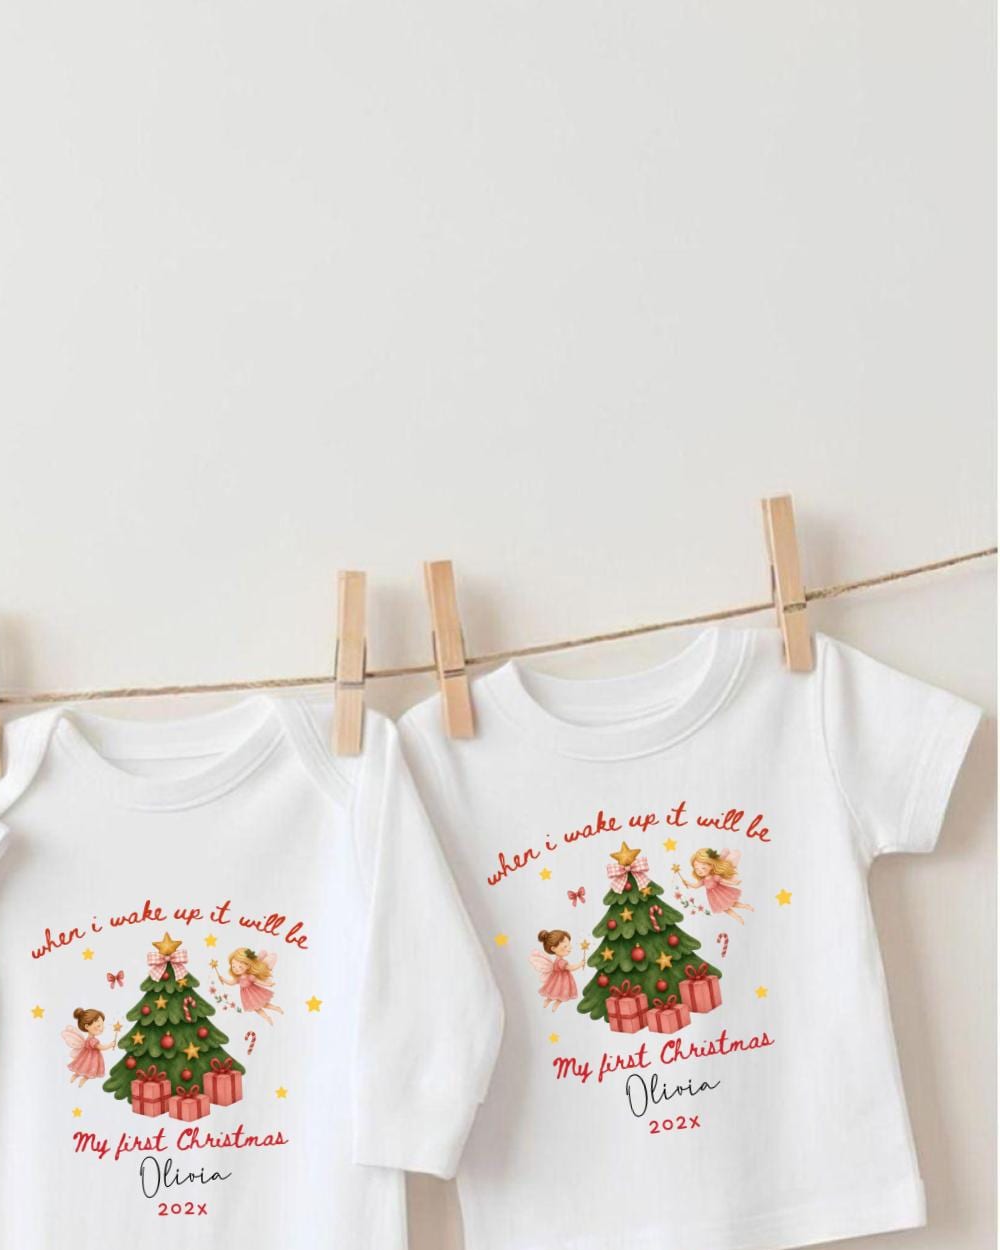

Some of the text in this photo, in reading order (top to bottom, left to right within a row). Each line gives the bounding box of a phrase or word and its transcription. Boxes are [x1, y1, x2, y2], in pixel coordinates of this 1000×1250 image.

[487, 801, 771, 887] when i wake up it will be
[31, 900, 309, 959] when i wake up it will be
[553, 1030, 775, 1083] My first Christmas
[626, 1073, 721, 1117] Olivia
[72, 1124, 289, 1160] My first Christmas
[139, 1156, 232, 1199] Olivia
